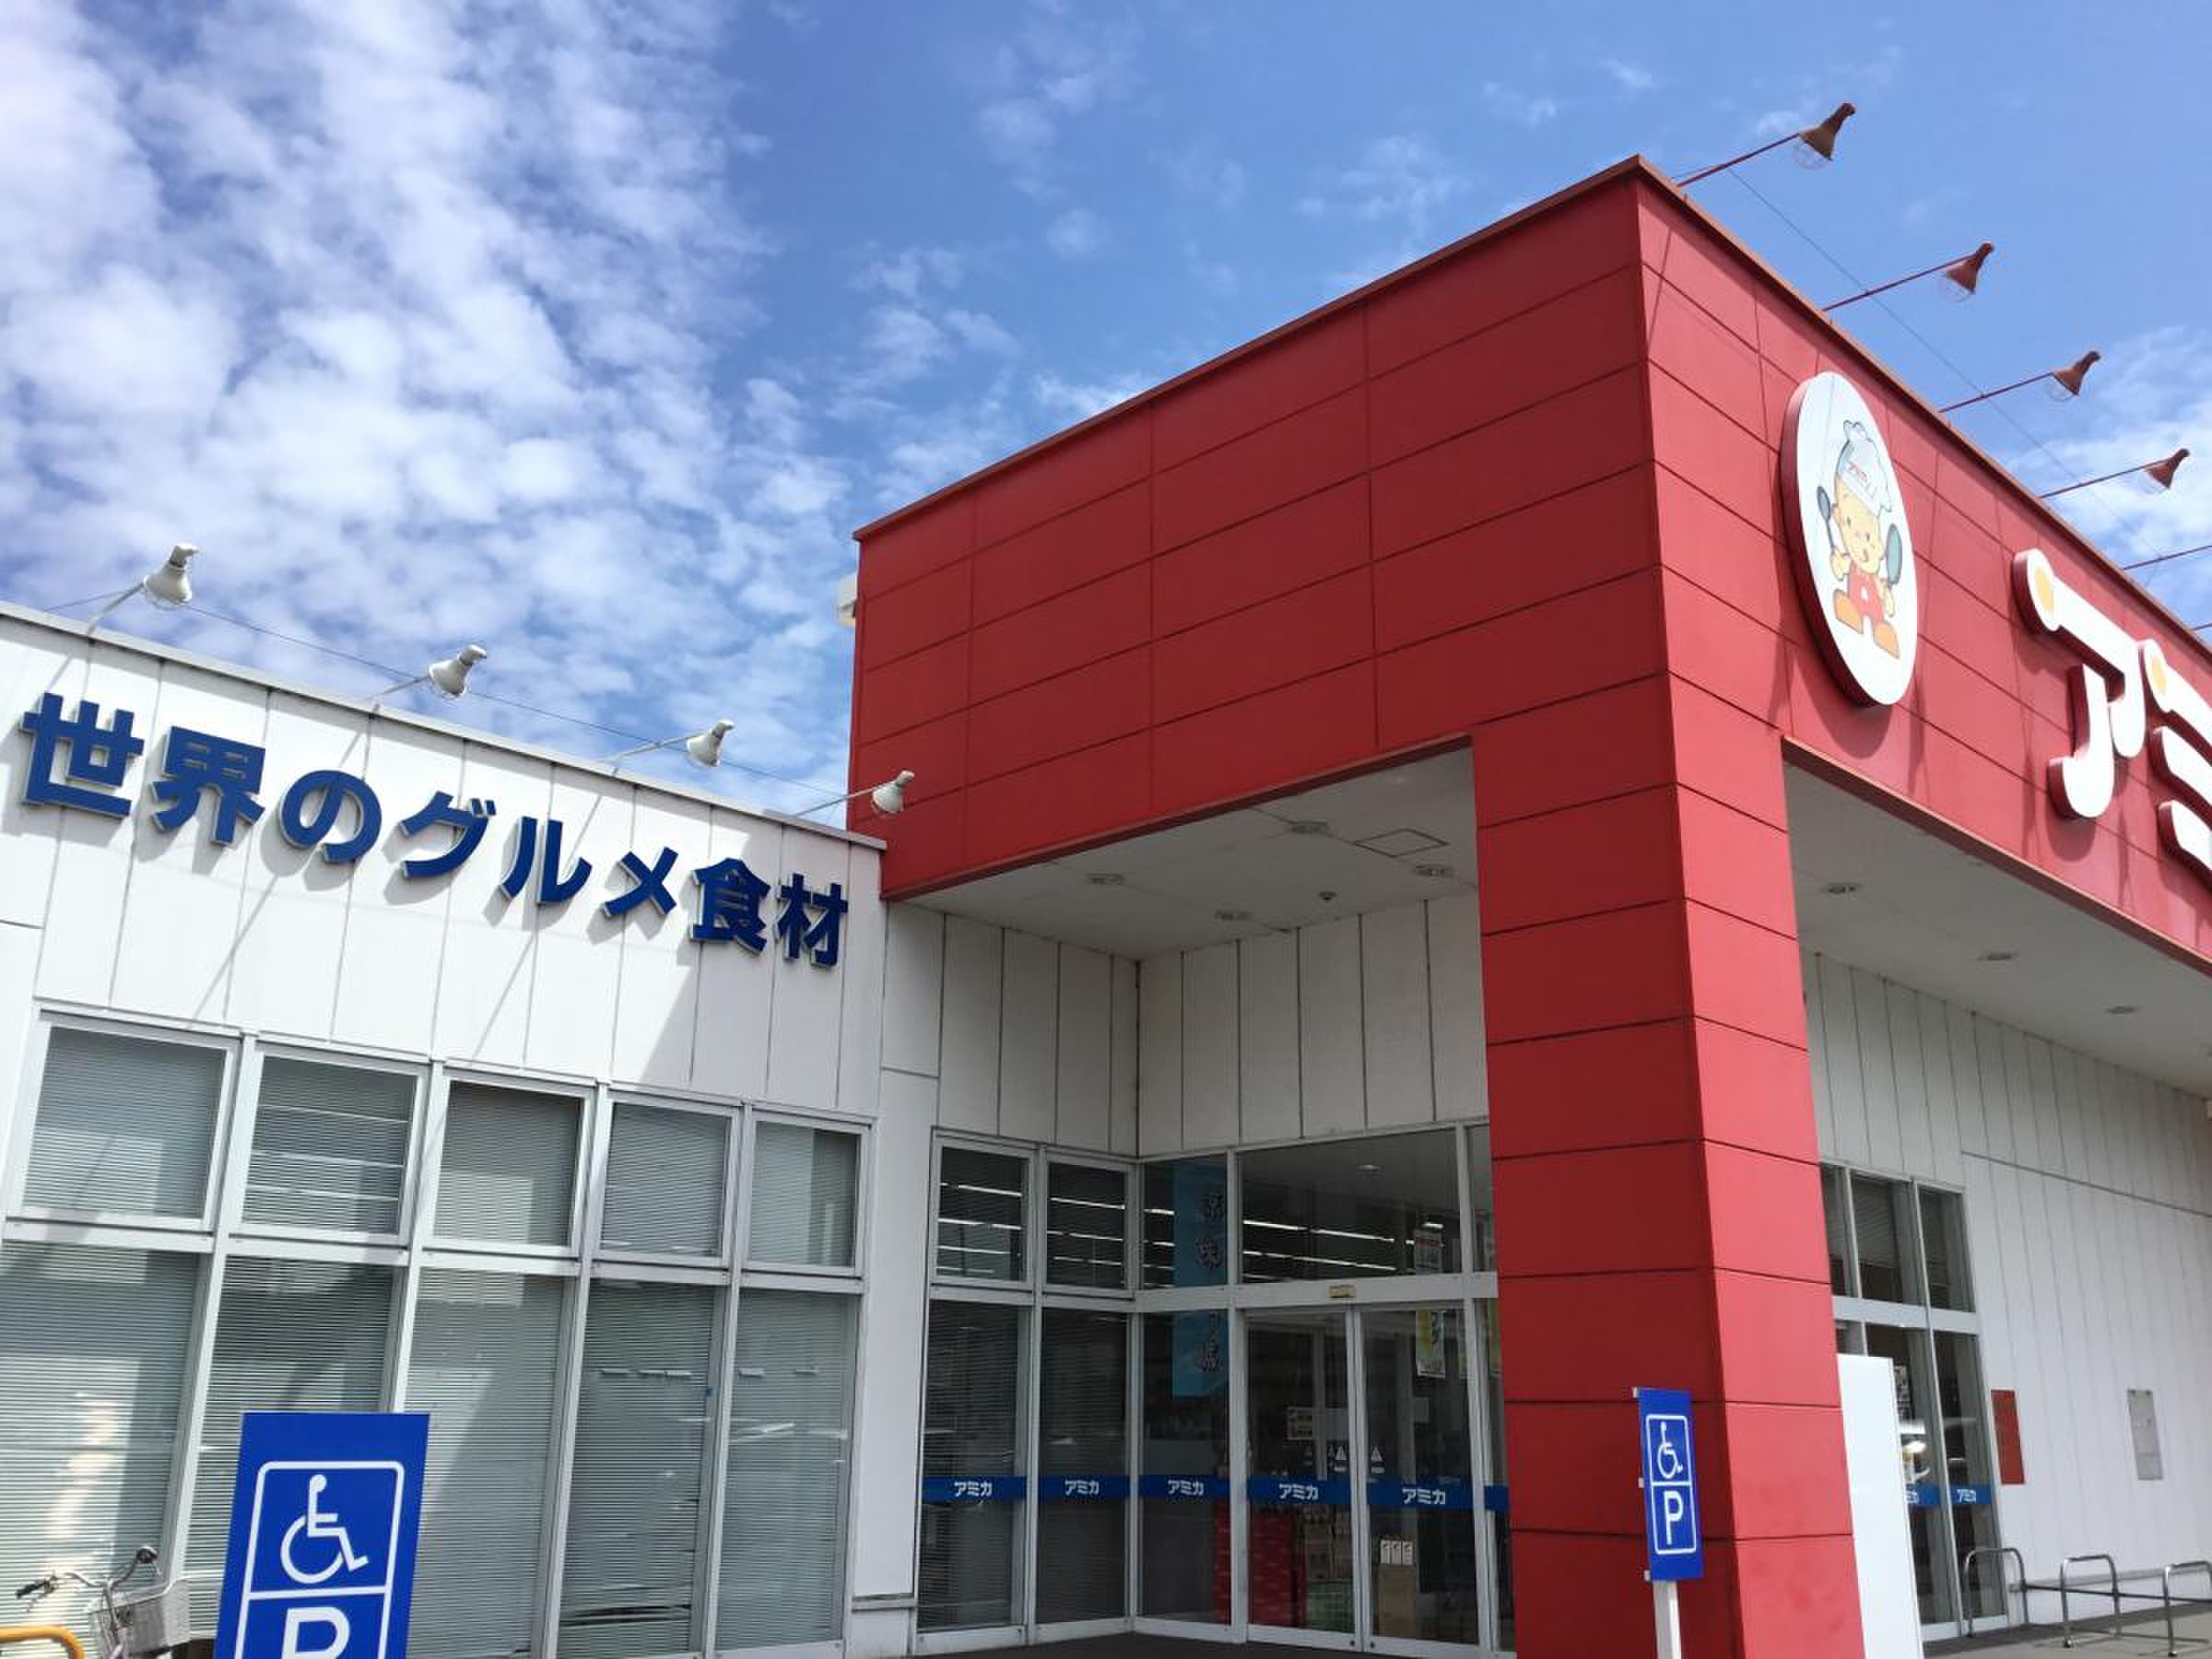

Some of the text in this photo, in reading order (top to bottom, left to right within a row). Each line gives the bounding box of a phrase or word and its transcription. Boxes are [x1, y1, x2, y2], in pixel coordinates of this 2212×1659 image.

[17, 692, 849, 968] 世界のグルメ食材
[954, 1480, 993, 1498] アミカ
[1064, 1479, 1100, 1497] アミカ
[1167, 1478, 1205, 1497] アミカ
[1278, 1483, 1319, 1500] アミカ
[1402, 1488, 1446, 1505] アミカ
[1664, 1490, 1684, 1546] P
[281, 1606, 350, 1659] P
